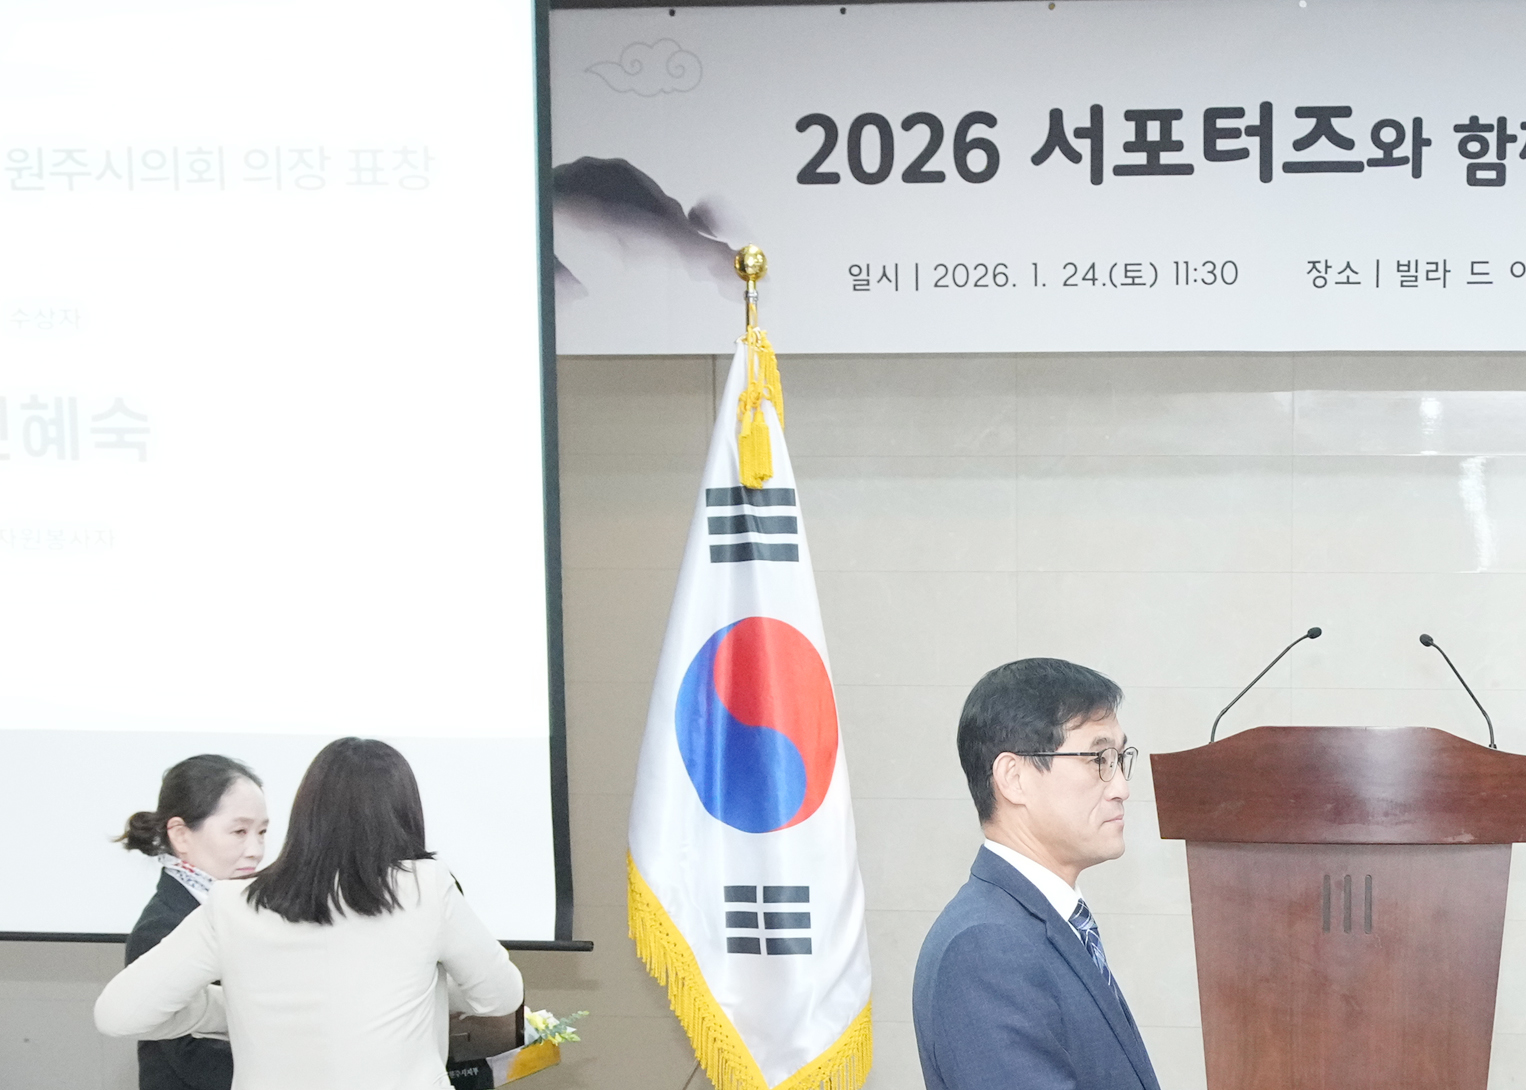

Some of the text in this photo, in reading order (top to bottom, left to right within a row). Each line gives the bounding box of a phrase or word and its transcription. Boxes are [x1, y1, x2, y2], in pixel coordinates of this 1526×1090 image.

[796, 111, 1000, 185] 2026
[1031, 101, 1432, 185] 서포터즈와
[5, 146, 435, 191] 원주시의회 의장 표창
[849, 263, 898, 291] 일시
[934, 263, 1016, 287] 2026.
[1032, 263, 1046, 287] 1.
[1063, 262, 1158, 288] 24.(토)
[1174, 260, 1238, 285] 11:30
[1307, 259, 1361, 288] 장소
[1397, 259, 1451, 288] 빌라
[1467, 261, 1493, 284] 드
